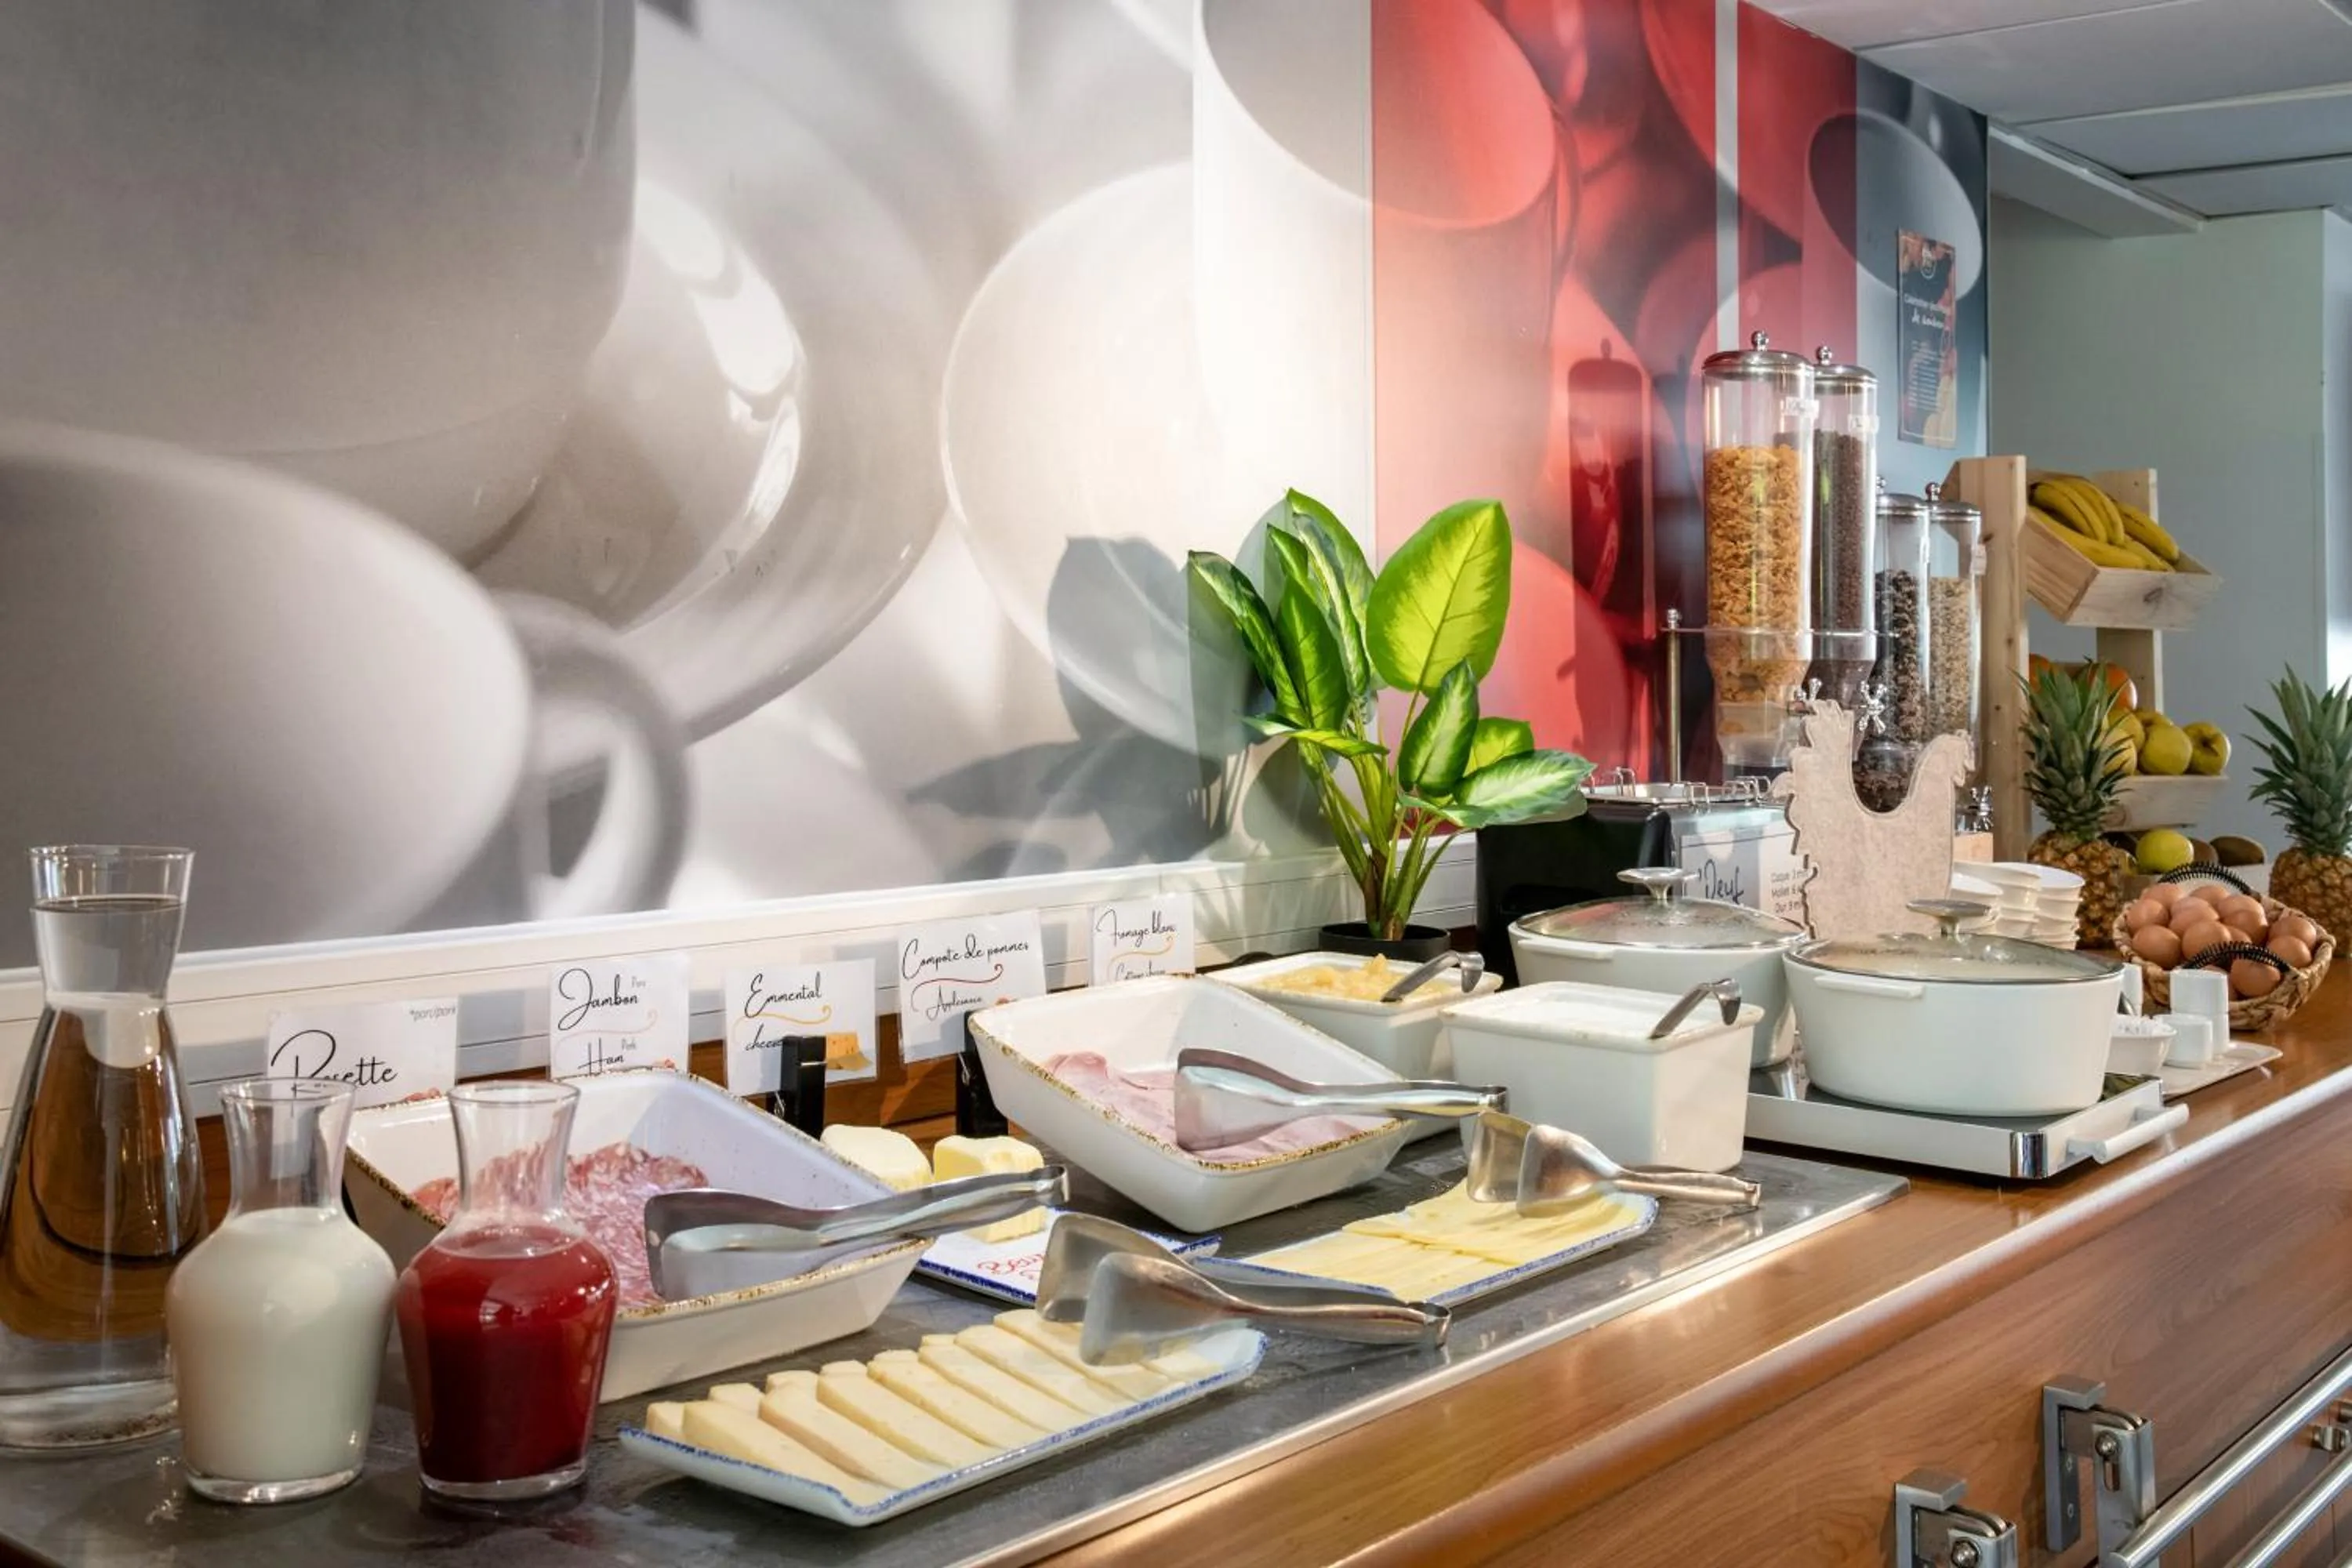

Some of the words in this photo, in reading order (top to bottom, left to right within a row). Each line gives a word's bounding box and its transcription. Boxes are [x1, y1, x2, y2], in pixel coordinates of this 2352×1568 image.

[902, 938, 962, 979] Compote
[964, 932, 985, 959] de
[986, 942, 1029, 963] pommes
[557, 967, 639, 1031] Jambon
[744, 972, 822, 1018] Emmental
[577, 1036, 624, 1076] Ham
